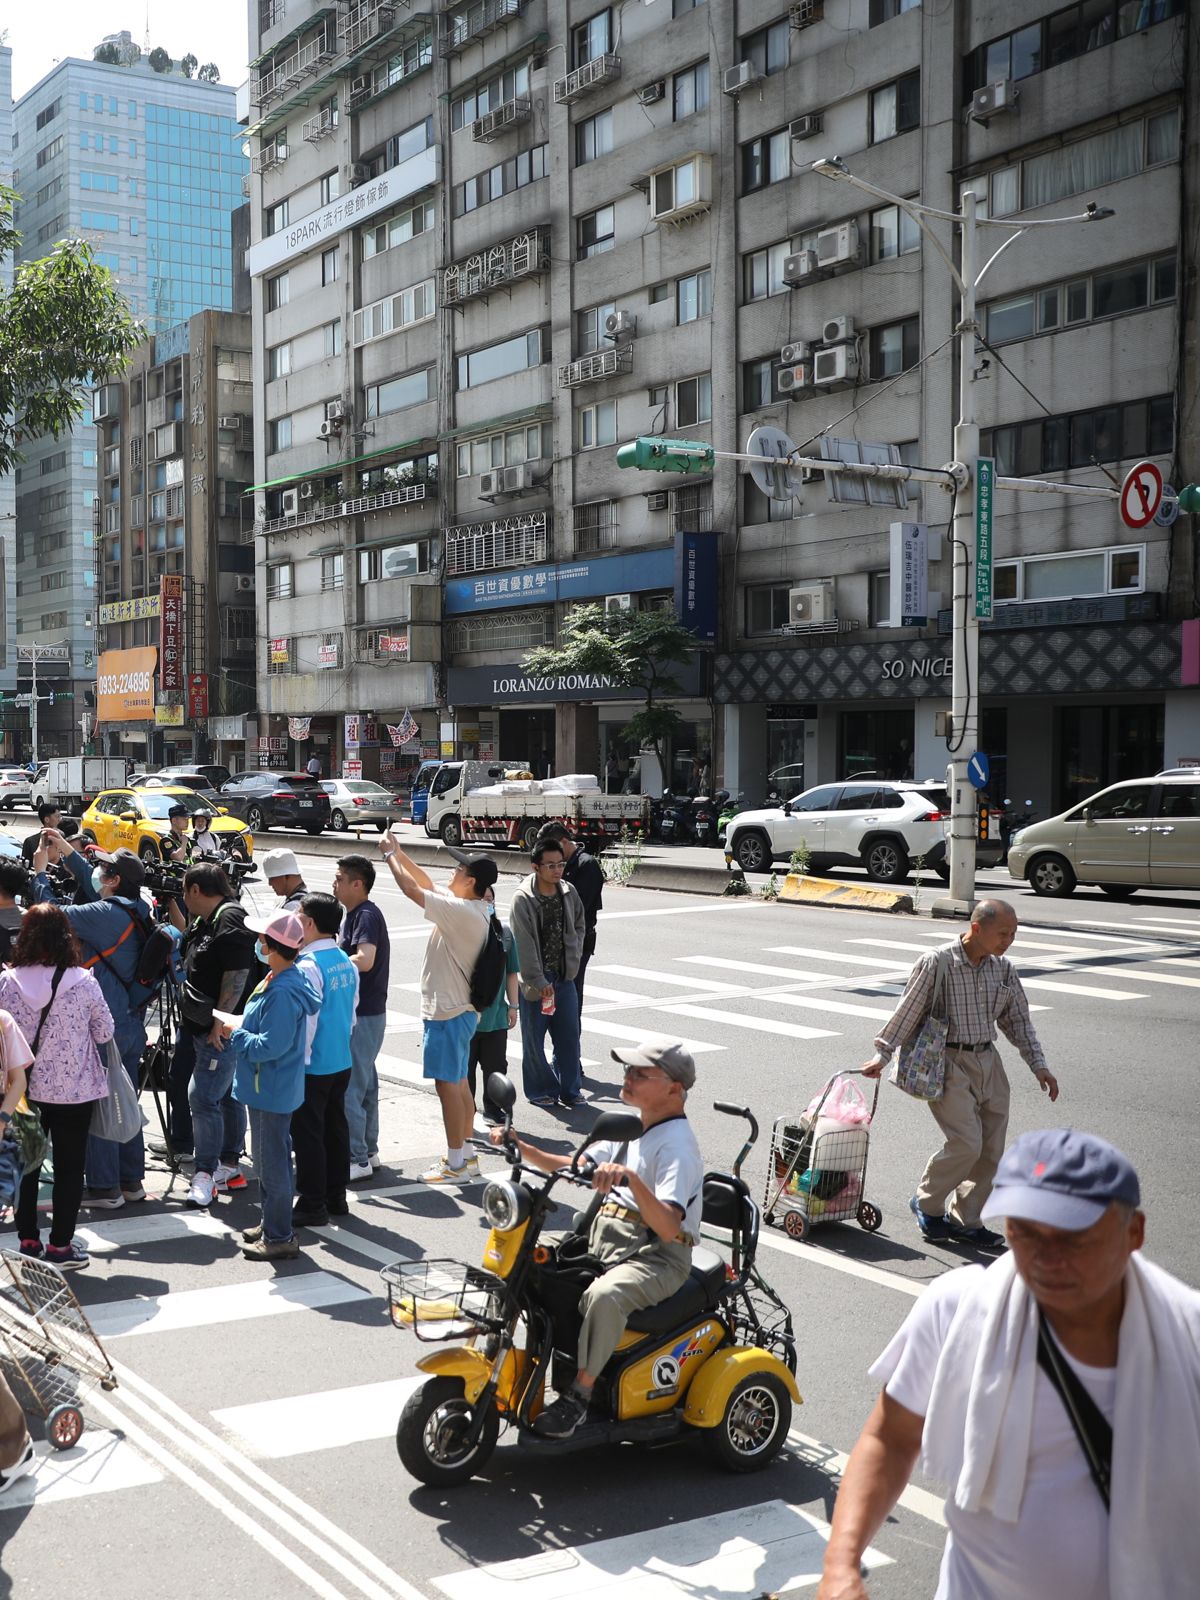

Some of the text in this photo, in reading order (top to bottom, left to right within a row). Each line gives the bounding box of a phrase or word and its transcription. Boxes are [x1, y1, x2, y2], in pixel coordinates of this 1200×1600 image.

[284, 217, 322, 251] 18PARK
[980, 486, 989, 561] 忠孝東路五段
[474, 573, 547, 595] 百世資優數學
[688, 549, 696, 611] 百世資優數學
[905, 617, 913, 626] 2F
[881, 657, 953, 679] SO NICE
[99, 671, 150, 695] 0933-224896
[493, 677, 556, 693] LORANZO
[127, 832, 134, 840] GO
